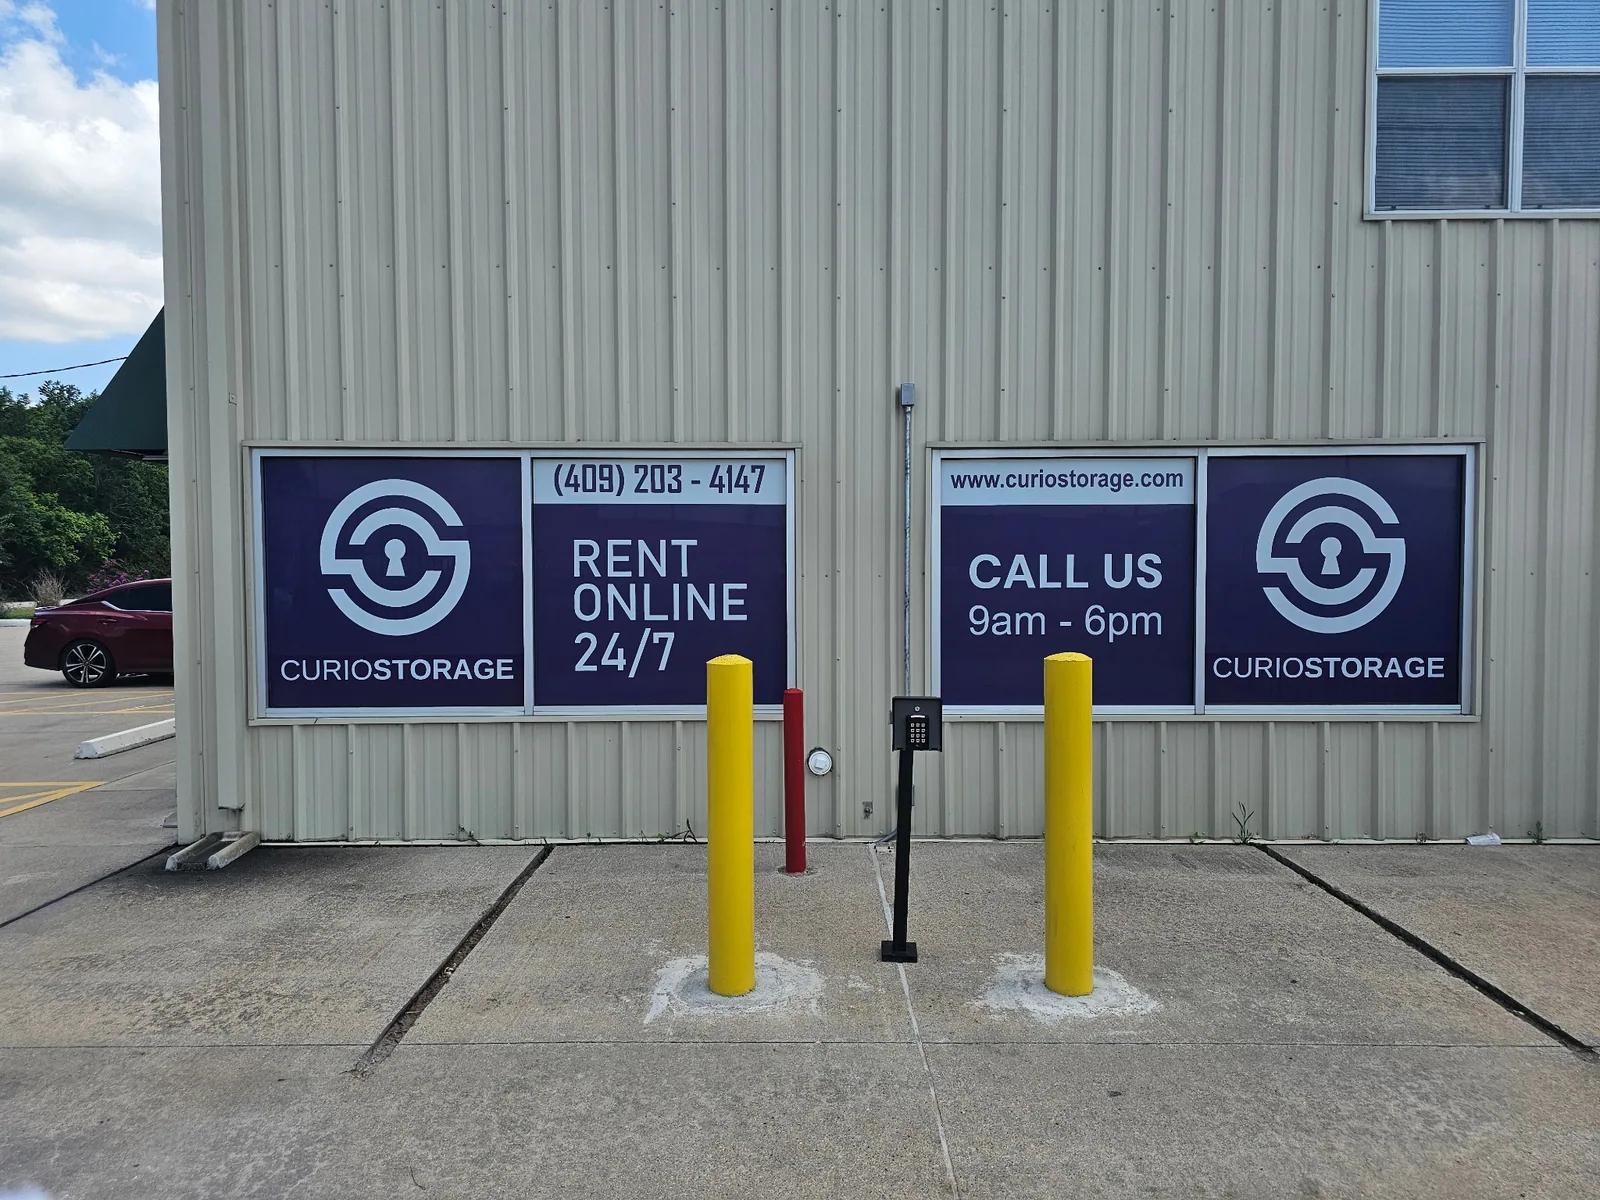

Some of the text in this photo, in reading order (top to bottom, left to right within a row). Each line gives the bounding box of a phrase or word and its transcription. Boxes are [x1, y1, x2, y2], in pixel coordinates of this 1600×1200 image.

[553, 463, 625, 497] (409)
[633, 464, 682, 494] 203
[708, 464, 766, 494] 4147
[950, 469, 1184, 493] www.curiostorage.com
[573, 539, 698, 578] RENT
[968, 553, 1163, 589] CALL US
[573, 583, 748, 622] ONLINE
[968, 604, 1046, 636] 9am
[1084, 604, 1162, 643] 6pm
[280, 658, 514, 681] CURIOSTORAGE
[574, 627, 675, 678] 24/7
[1213, 657, 1445, 678] CURIOSTORAGE
